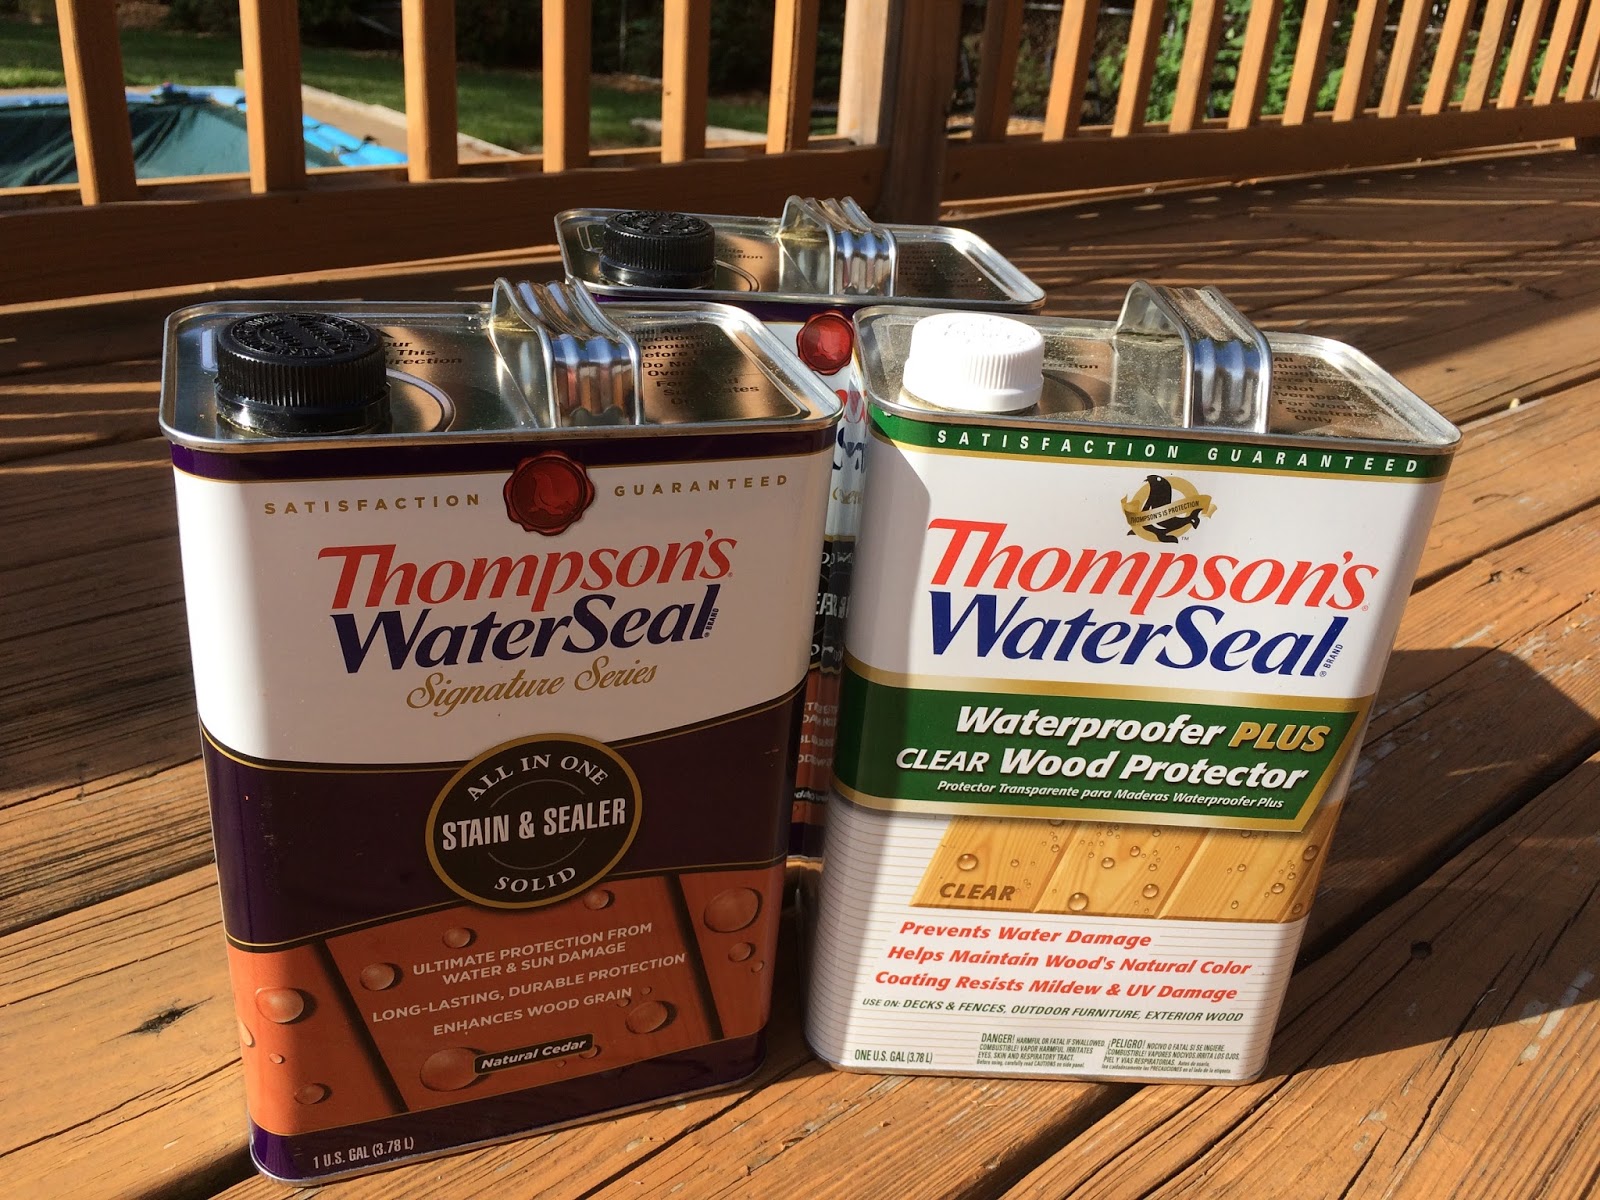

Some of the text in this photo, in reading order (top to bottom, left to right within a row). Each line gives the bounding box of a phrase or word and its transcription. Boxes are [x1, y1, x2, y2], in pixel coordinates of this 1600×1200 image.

[643, 361, 663, 369] Do
[1294, 415, 1333, 424] Only
[937, 430, 1419, 474] SATISFACTION GUARANTEED
[614, 475, 787, 497] GUARANTEED
[264, 494, 479, 515] SATISFACTION
[1130, 510, 1162, 524] THOMPSON'S
[1168, 500, 1200, 514] PROTECTION
[318, 529, 737, 612] Thompson's
[928, 518, 1379, 615] Thompson's
[330, 584, 720, 674] WaterSeal
[706, 608, 719, 630] BRAND
[928, 591, 1348, 678] WaterSeal
[1323, 644, 1343, 668] BRAND
[407, 655, 657, 717] Signature Series
[956, 706, 1331, 751] Waterproofer PLUS
[467, 754, 608, 801] ALL IN ONE
[896, 748, 1308, 790] CLEAR Wood Protector
[937, 780, 1284, 810] Protector Transparente para Maderas Waterproofer Plus
[442, 798, 626, 850] STAIN & SEALER
[494, 866, 576, 893] SOLID
[939, 882, 1015, 901] CLEAR
[413, 922, 653, 976] ULTIMATE PROTECTION FROM
[900, 921, 1151, 950] Prevents Water Damage
[442, 942, 626, 985] WATER & SUN DAMAGE
[887, 946, 1252, 976] Helps Maintain Wood's Natural Color
[372, 953, 686, 1023] LONG-LASTING, DURABLE PROTECTION
[875, 971, 1238, 1003] Coating Resists Mildew & UV Damage
[433, 988, 632, 1036] ENHANCES WOOD GRAIN
[862, 998, 1243, 1022] USE ON: DECKS & FENCES, OUTDOOR FURNITURE, EXTERIOR WOOD
[981, 1033, 1016, 1044] DANGER!
[481, 1039, 586, 1070] Natural Cedar
[855, 1049, 933, 1064] ONE U.S. GAL (3.78 L)
[312, 1136, 415, 1169] 1 U.S. GAL (3.78 L)
